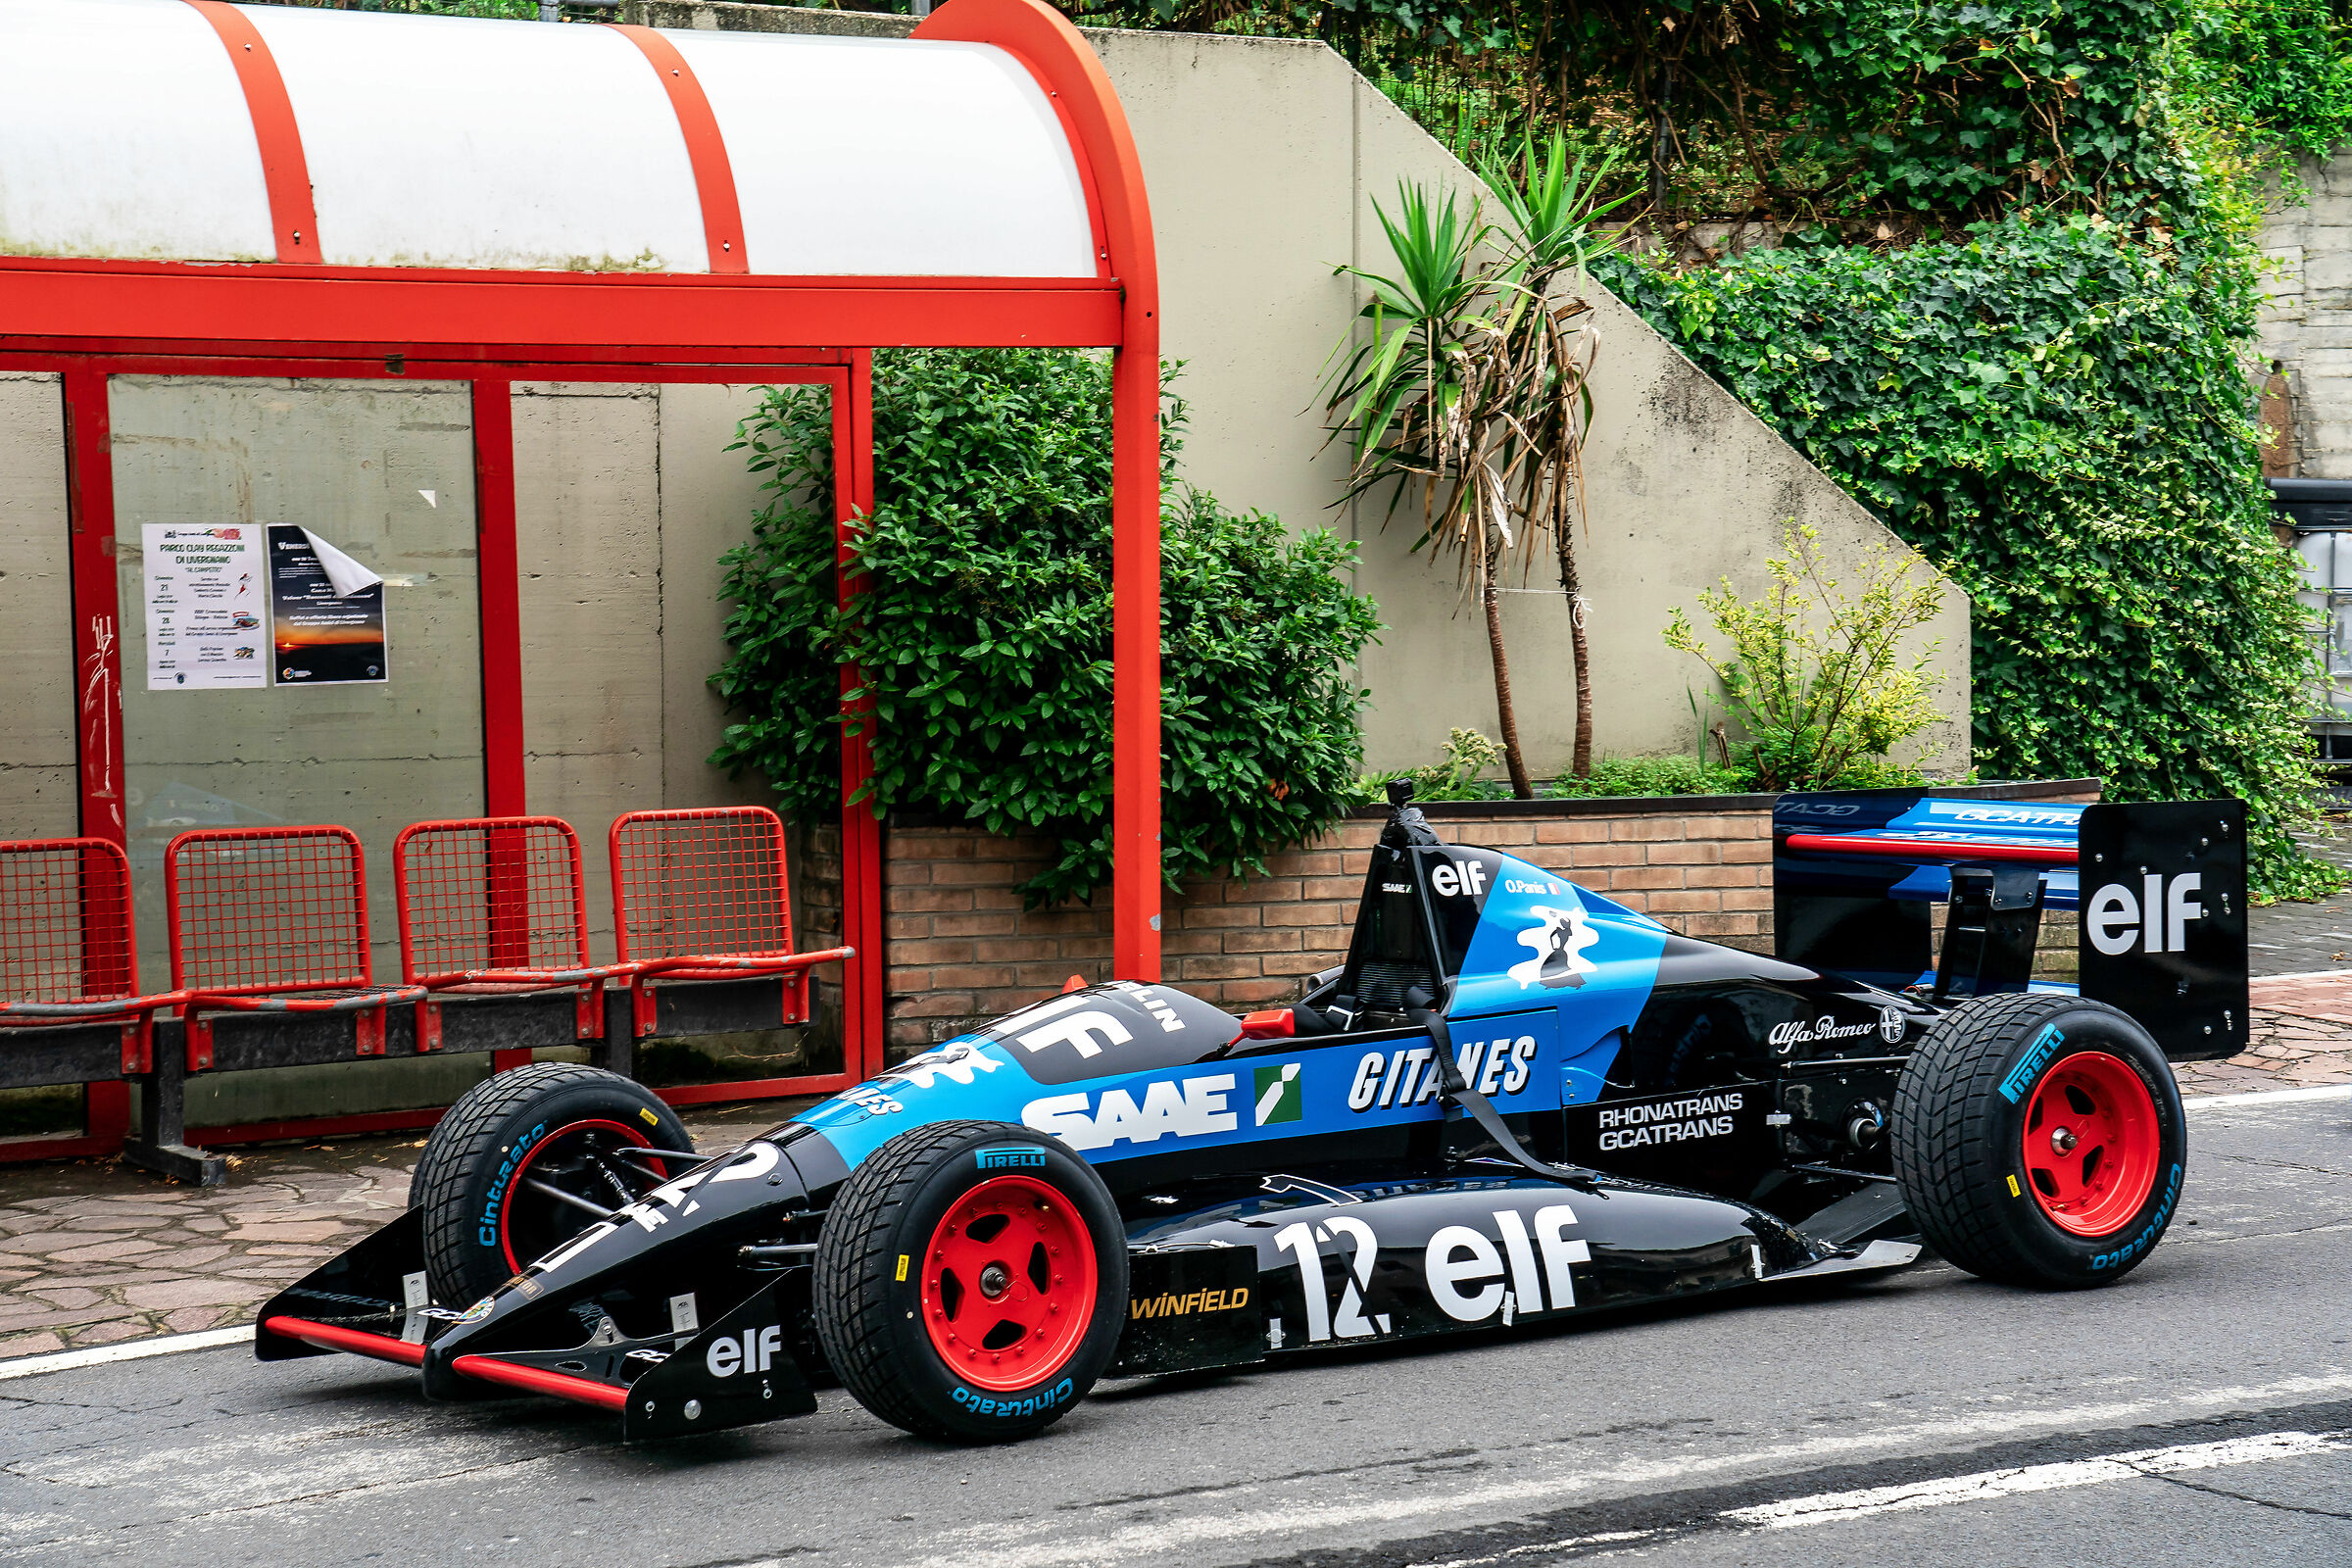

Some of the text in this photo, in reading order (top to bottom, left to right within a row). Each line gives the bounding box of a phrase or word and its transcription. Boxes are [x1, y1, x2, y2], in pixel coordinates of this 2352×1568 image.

[1432, 860, 1487, 897] elf
[2087, 872, 2201, 956] elf
[1768, 1015, 1876, 1054] Alfa Romeo
[1998, 1022, 2066, 1104] PIRELLI
[1348, 1035, 1537, 1111] GITANES
[1021, 1073, 1238, 1151] SAAE
[1598, 1115, 1734, 1152] GCATRANS
[1599, 1093, 1743, 1129] RHONATRANS
[974, 1147, 1047, 1169] PIRELLI
[1273, 1215, 1392, 1343] 12
[1425, 1204, 1592, 1322] elf
[707, 1324, 782, 1378] elf
